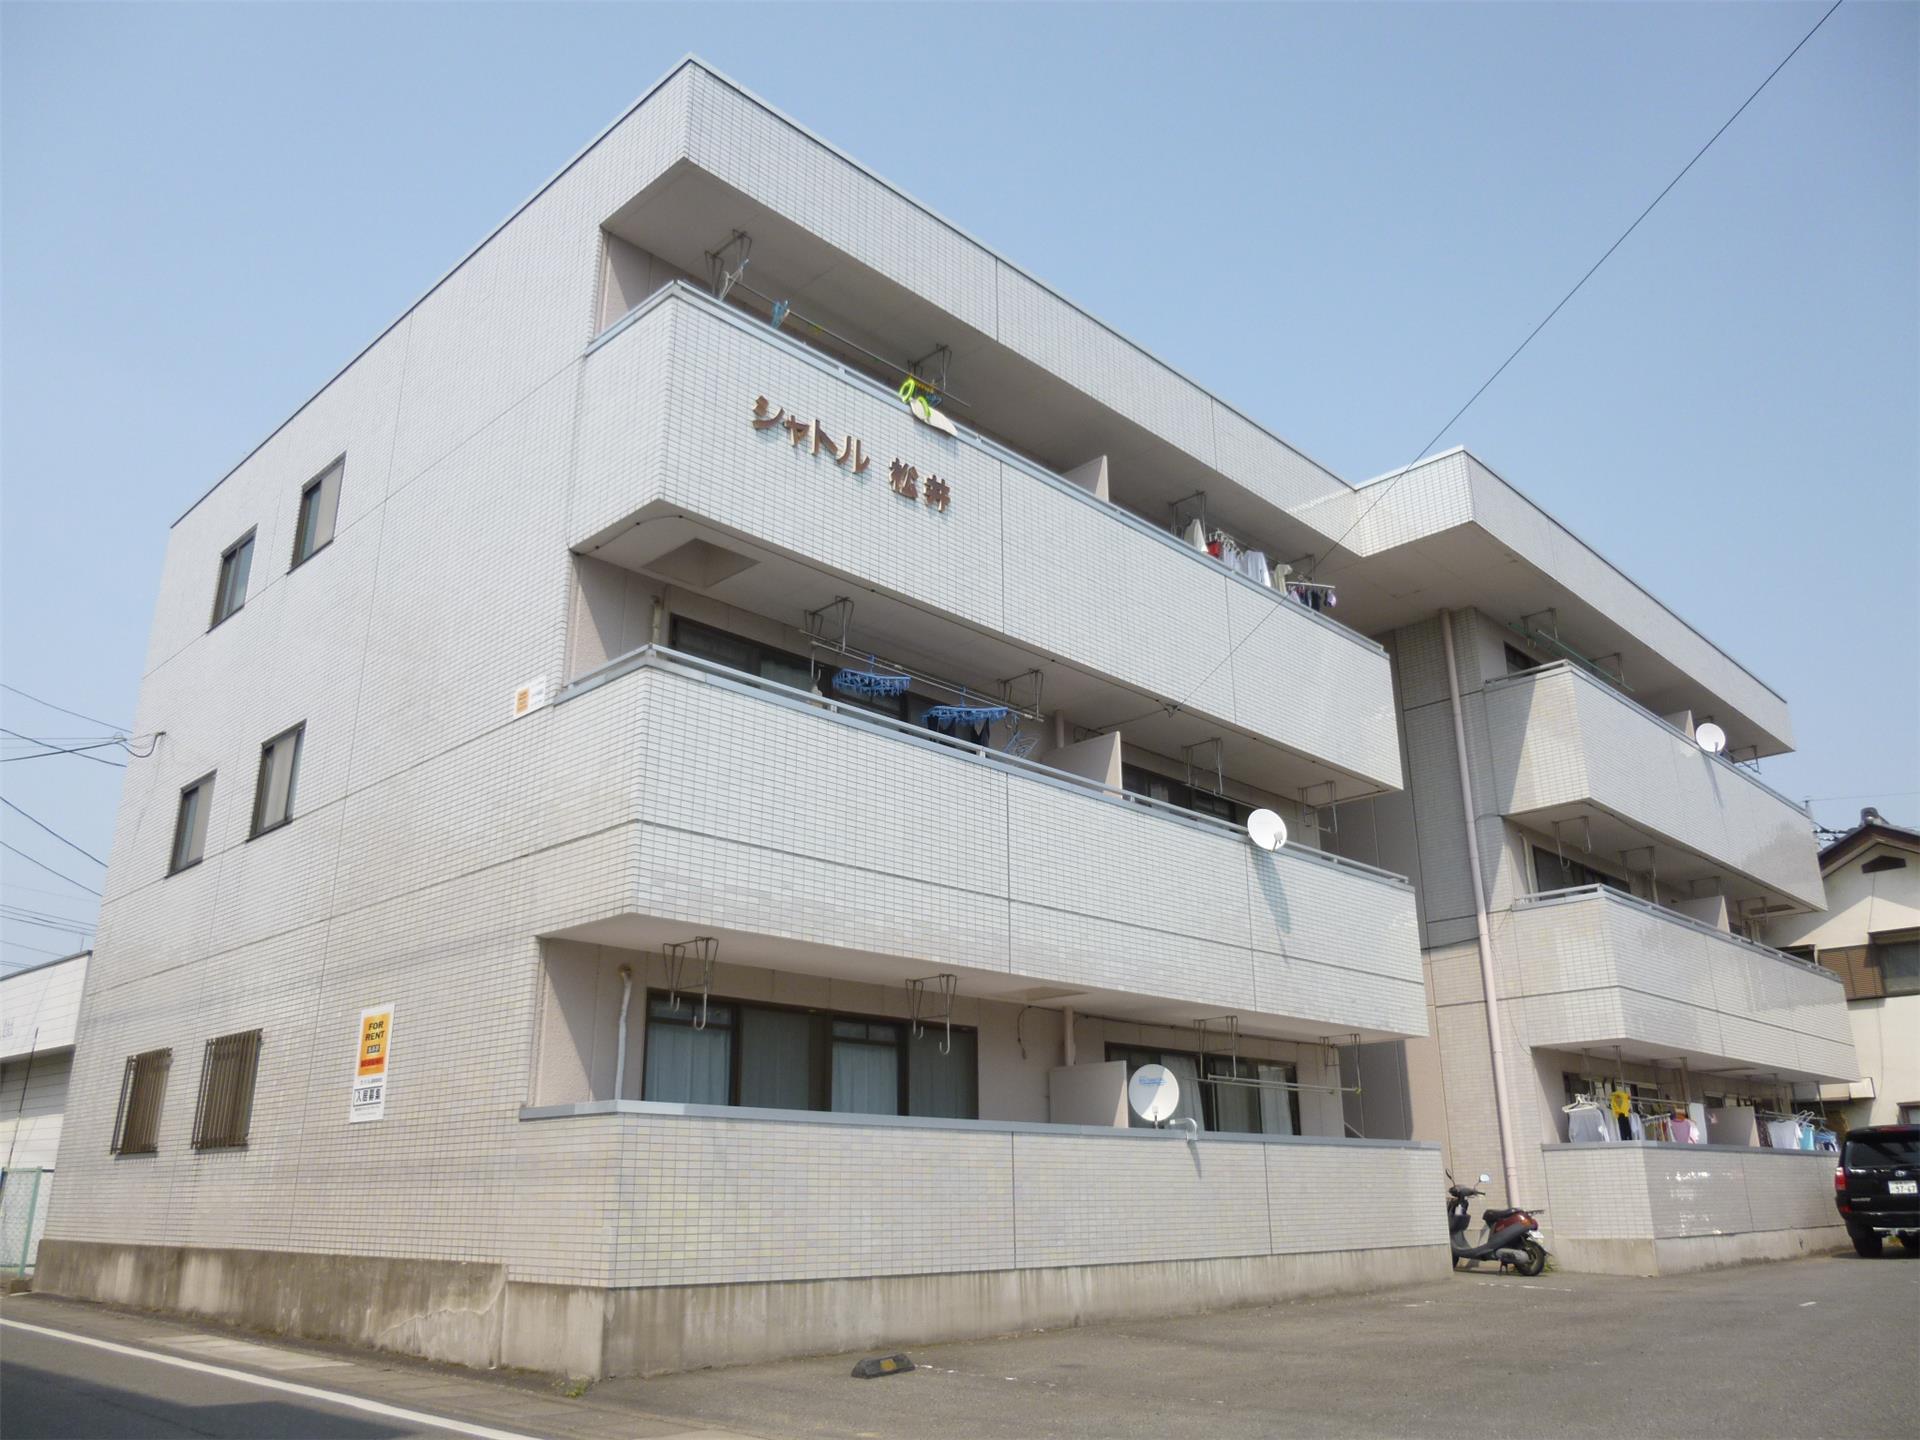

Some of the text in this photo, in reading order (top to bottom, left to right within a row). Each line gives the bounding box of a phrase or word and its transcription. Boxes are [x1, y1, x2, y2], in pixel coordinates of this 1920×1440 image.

[752, 395, 951, 513] シャトル 松井
[368, 1020, 384, 1031] FOR
[365, 1031, 385, 1041] RENT
[356, 1089, 381, 1103] 入居募集
